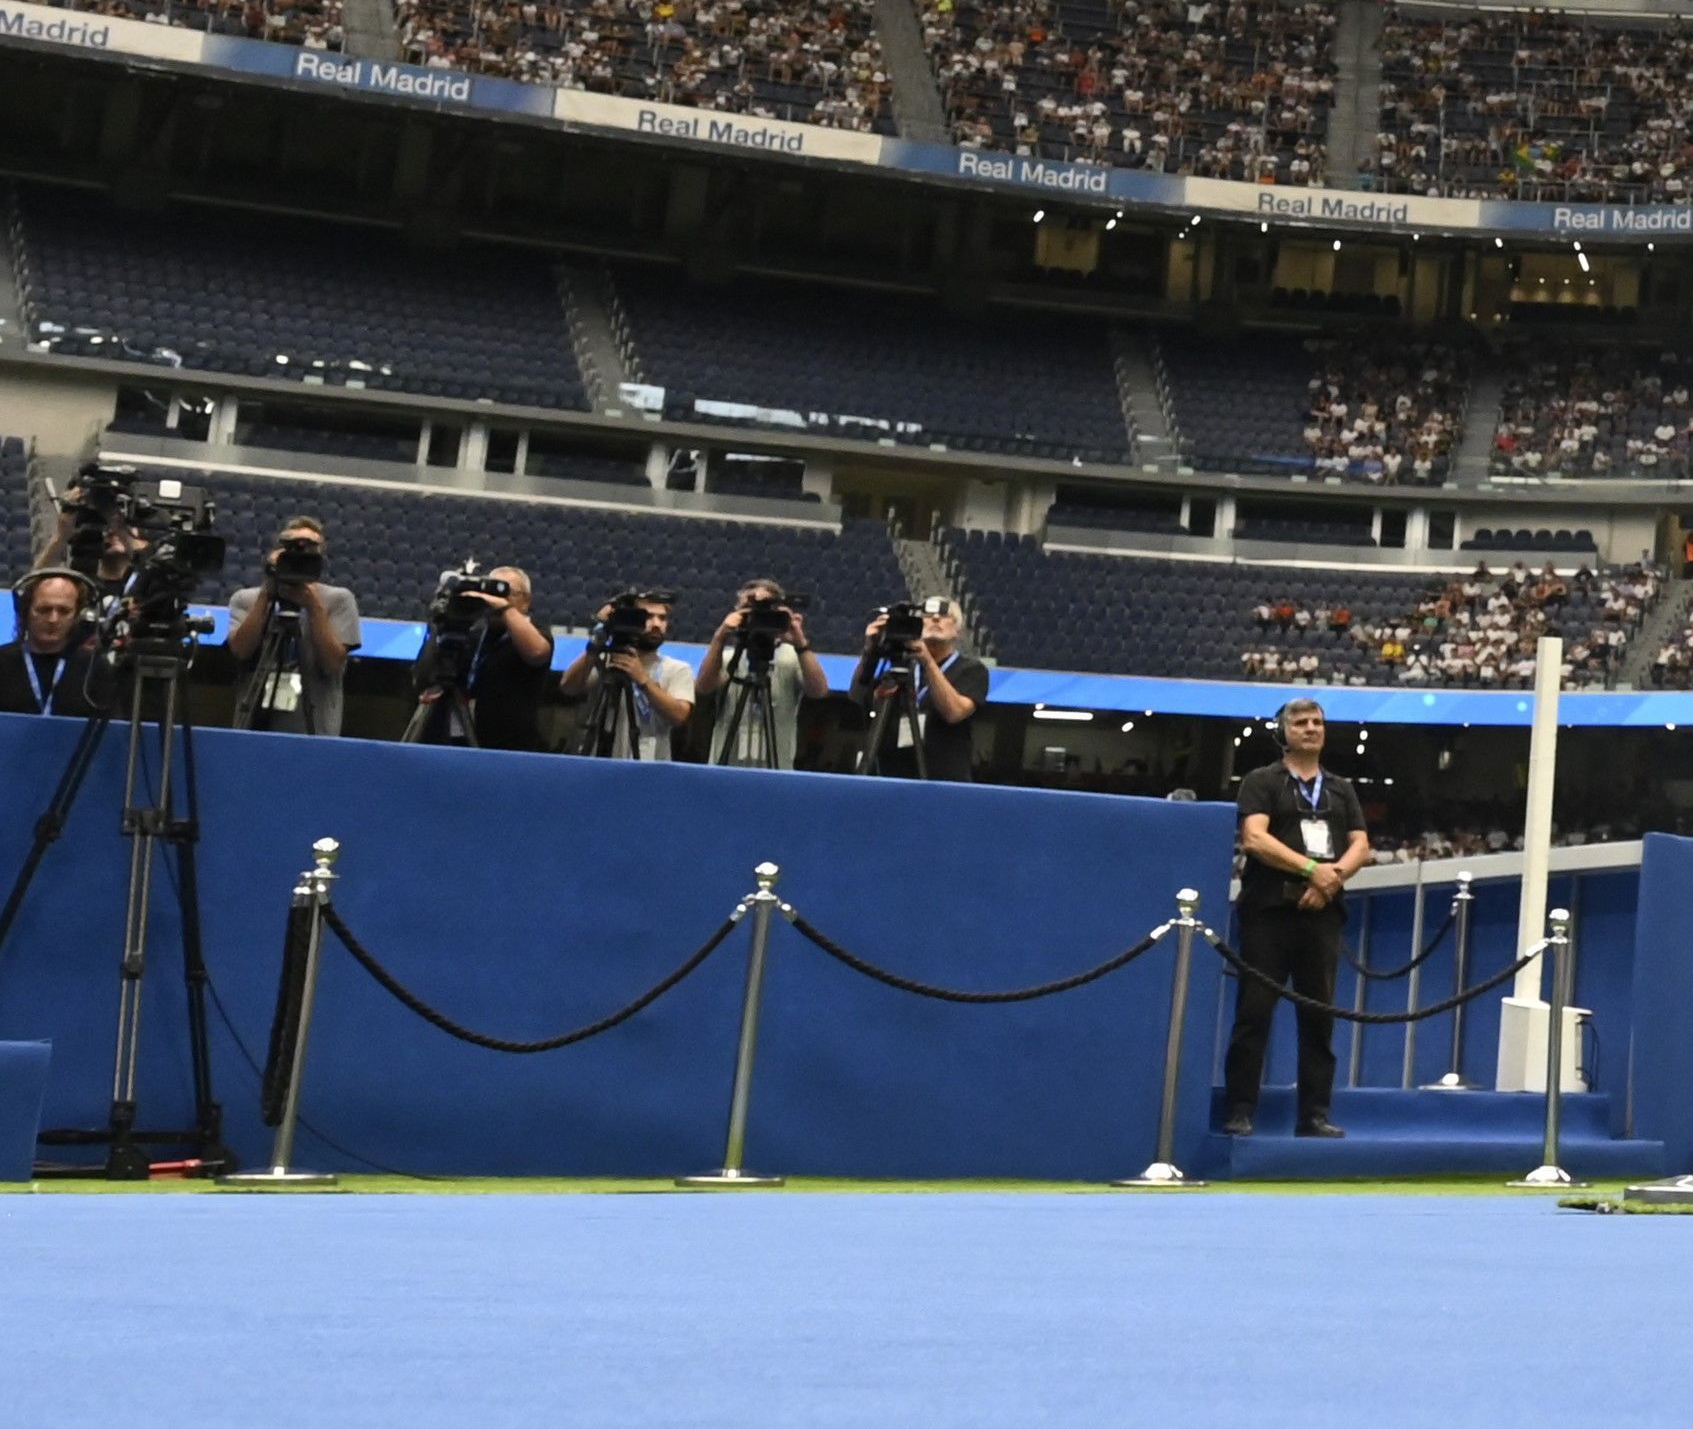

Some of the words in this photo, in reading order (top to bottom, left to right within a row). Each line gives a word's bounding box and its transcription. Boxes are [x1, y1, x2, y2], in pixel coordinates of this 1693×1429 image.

[0, 10, 109, 47] Madrid
[297, 52, 362, 84] Real
[369, 64, 470, 101] Madrid
[638, 110, 699, 136] Real
[708, 120, 804, 152] Madrid
[959, 152, 1014, 180] Real
[1021, 161, 1107, 192] Madrid
[1258, 192, 1312, 214] Real
[1321, 198, 1408, 221] Madrid
[1554, 207, 1605, 228] Real
[1612, 209, 1691, 230] Madrid
